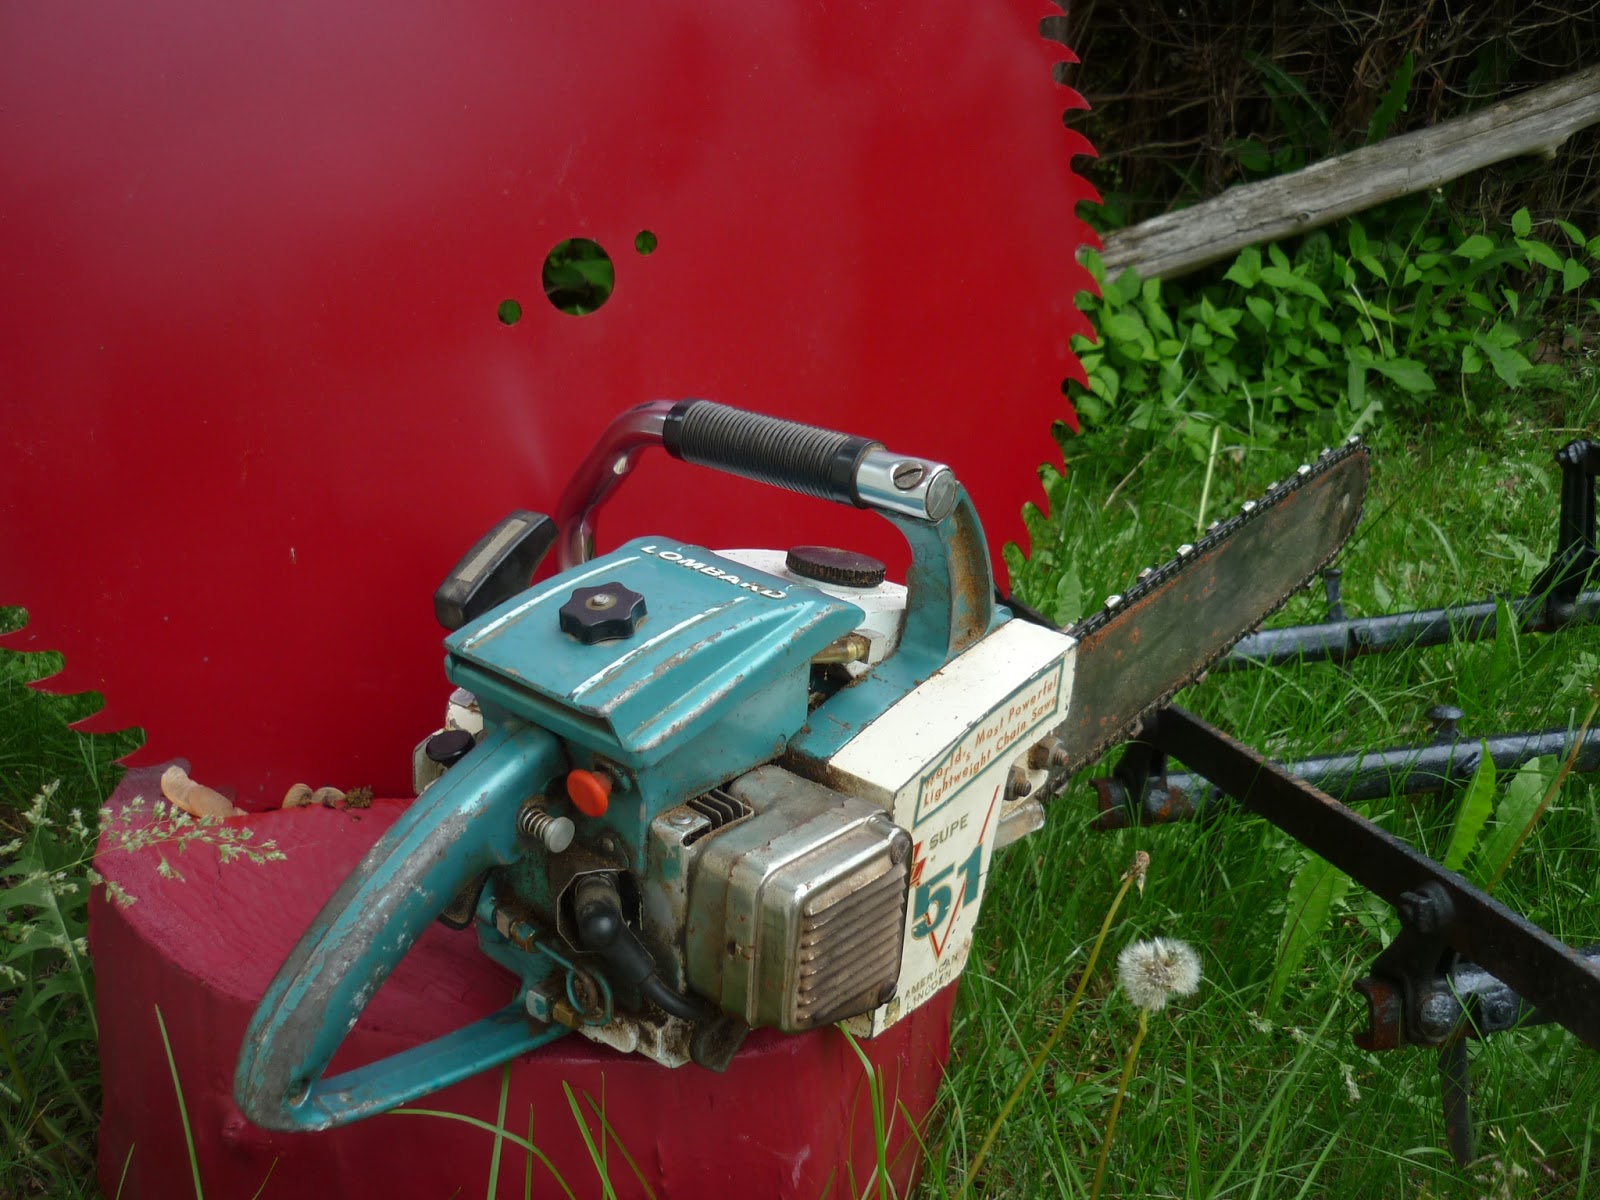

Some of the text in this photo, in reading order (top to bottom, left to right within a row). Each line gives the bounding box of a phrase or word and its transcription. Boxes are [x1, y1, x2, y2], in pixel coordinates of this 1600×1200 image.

[640, 545, 787, 599] LOMBARD
[923, 695, 1056, 807] Lightweight Chain Saws
[925, 673, 1057, 789] World's Most Powerful
[911, 843, 983, 940] 51
[905, 953, 958, 1001] AMERICAN
